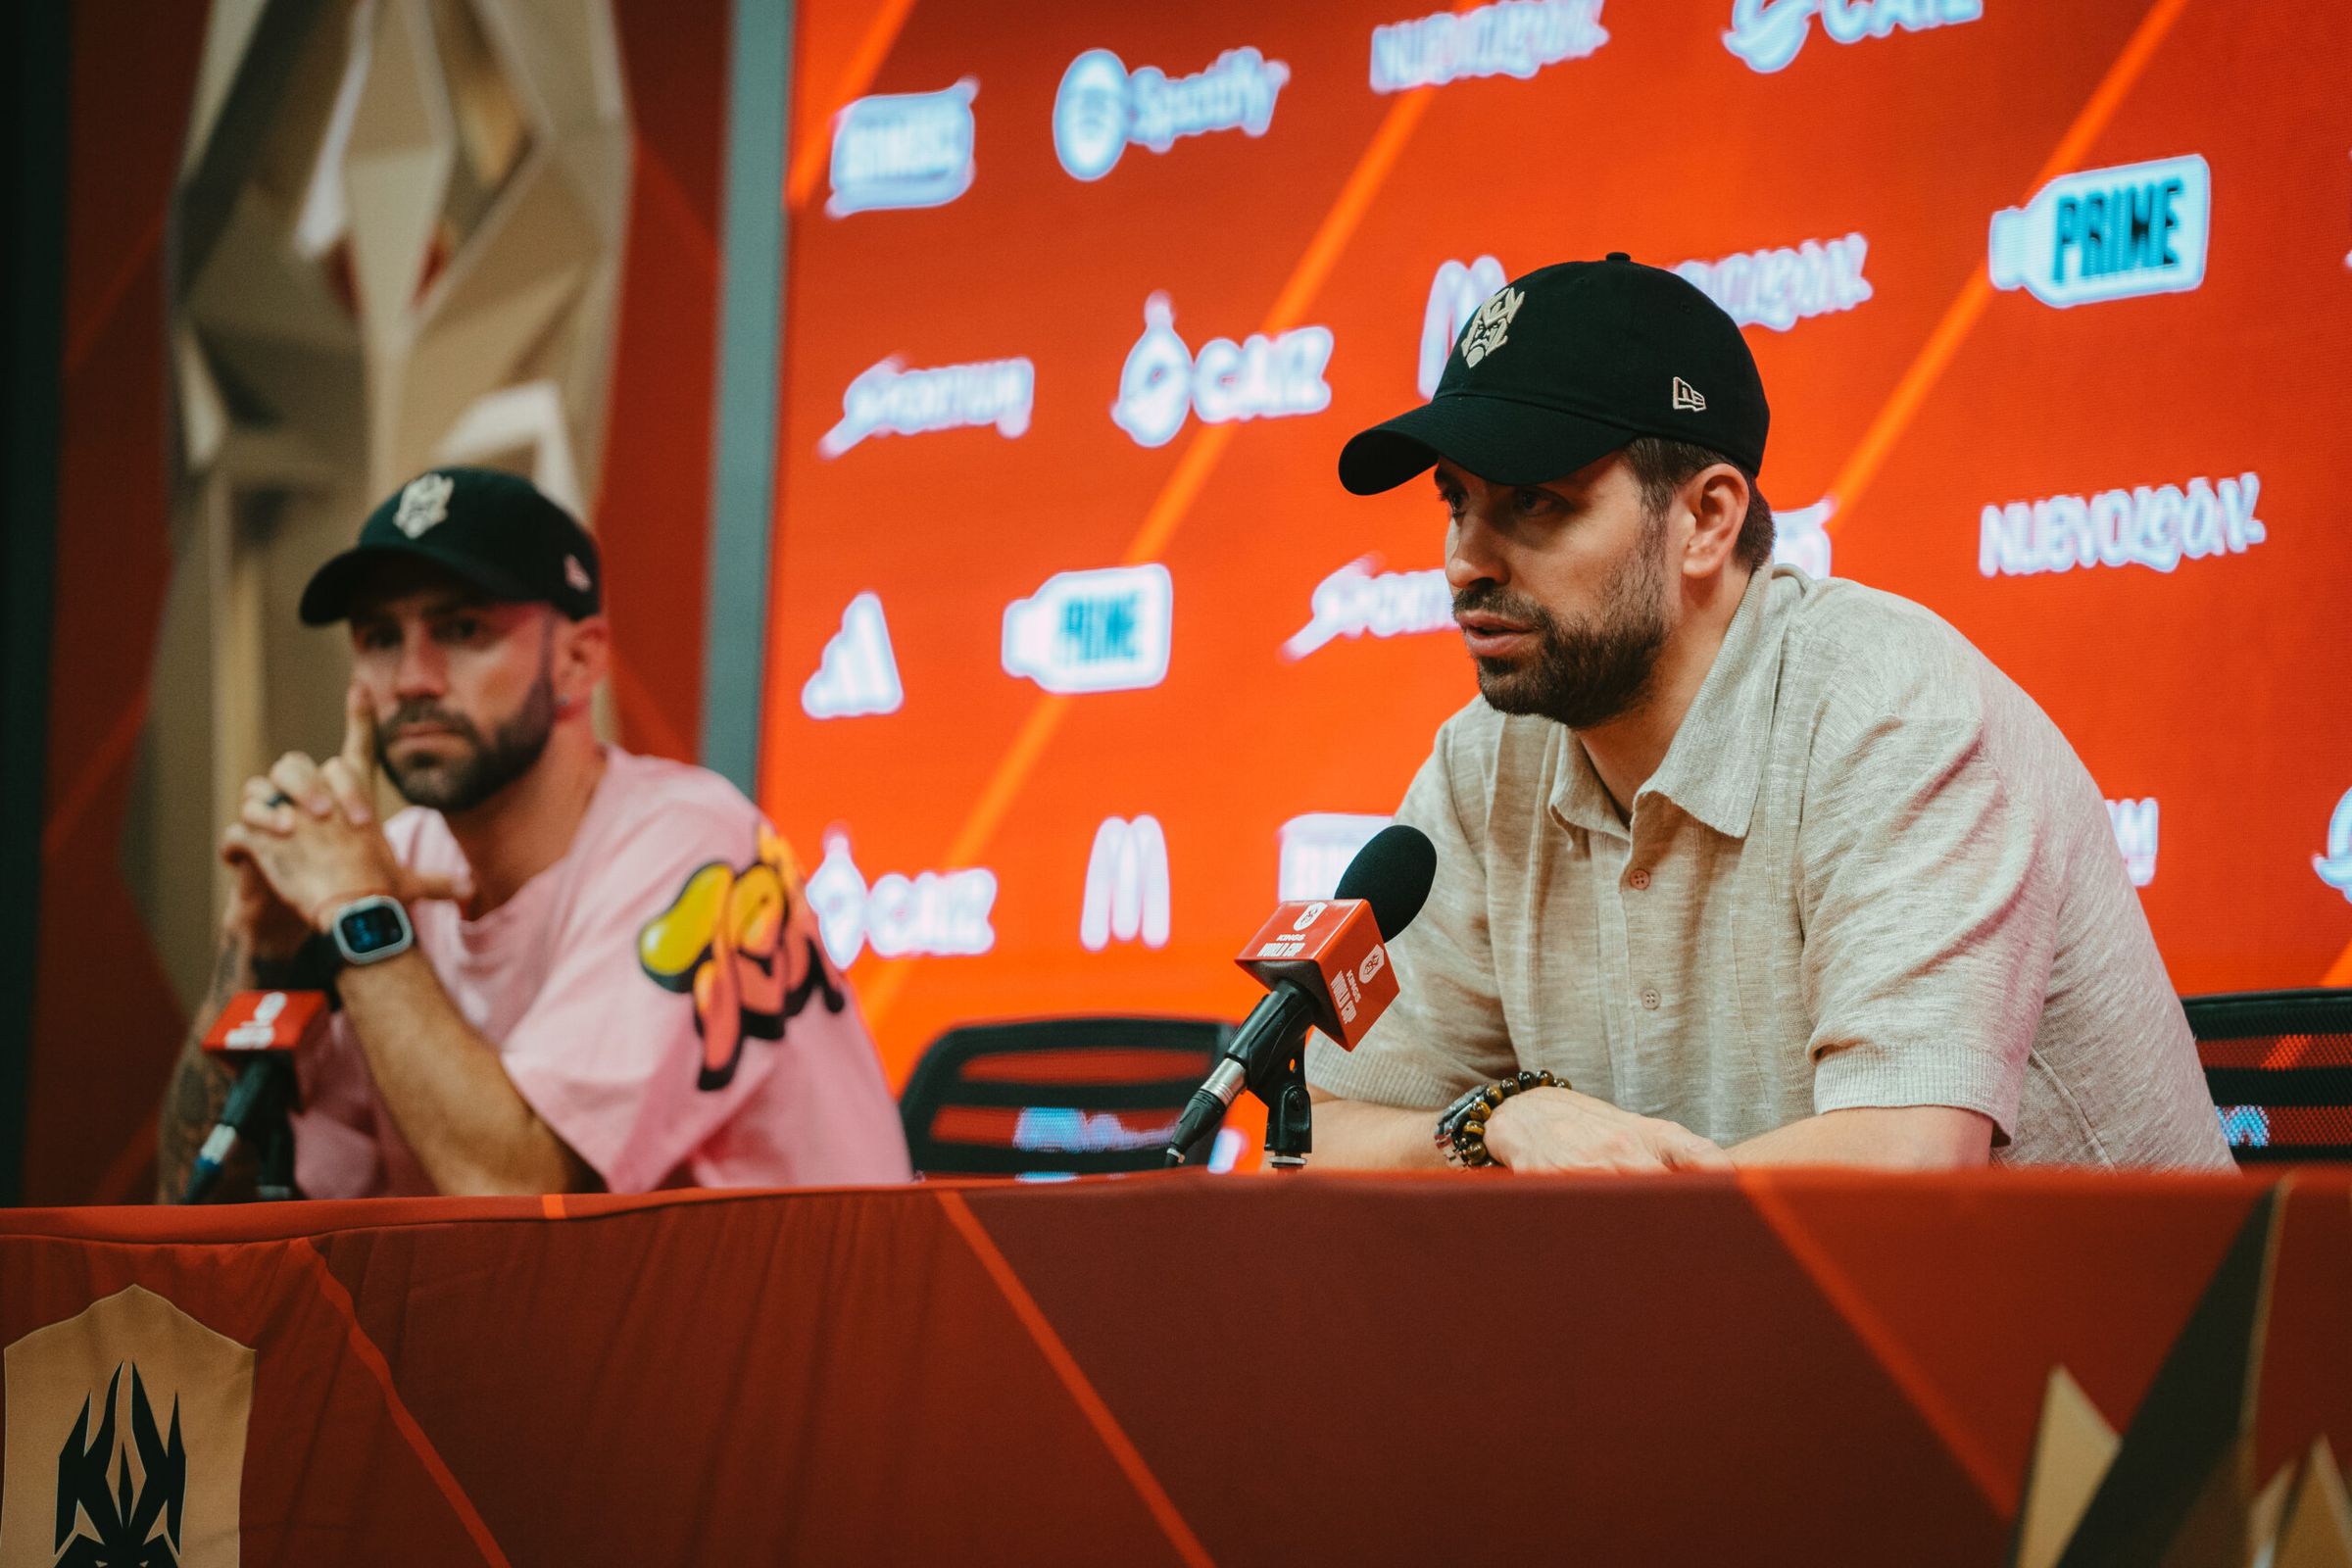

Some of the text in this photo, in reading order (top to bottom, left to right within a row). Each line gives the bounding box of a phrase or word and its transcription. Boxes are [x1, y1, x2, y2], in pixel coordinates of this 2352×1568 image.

[1127, 47, 1290, 154] Spotify
[2050, 176, 2184, 286] PRIME
[1060, 592, 1145, 665] PRIME
[1330, 970, 1357, 1025] WORLD CUP
[1347, 969, 1361, 1004] KINGS
